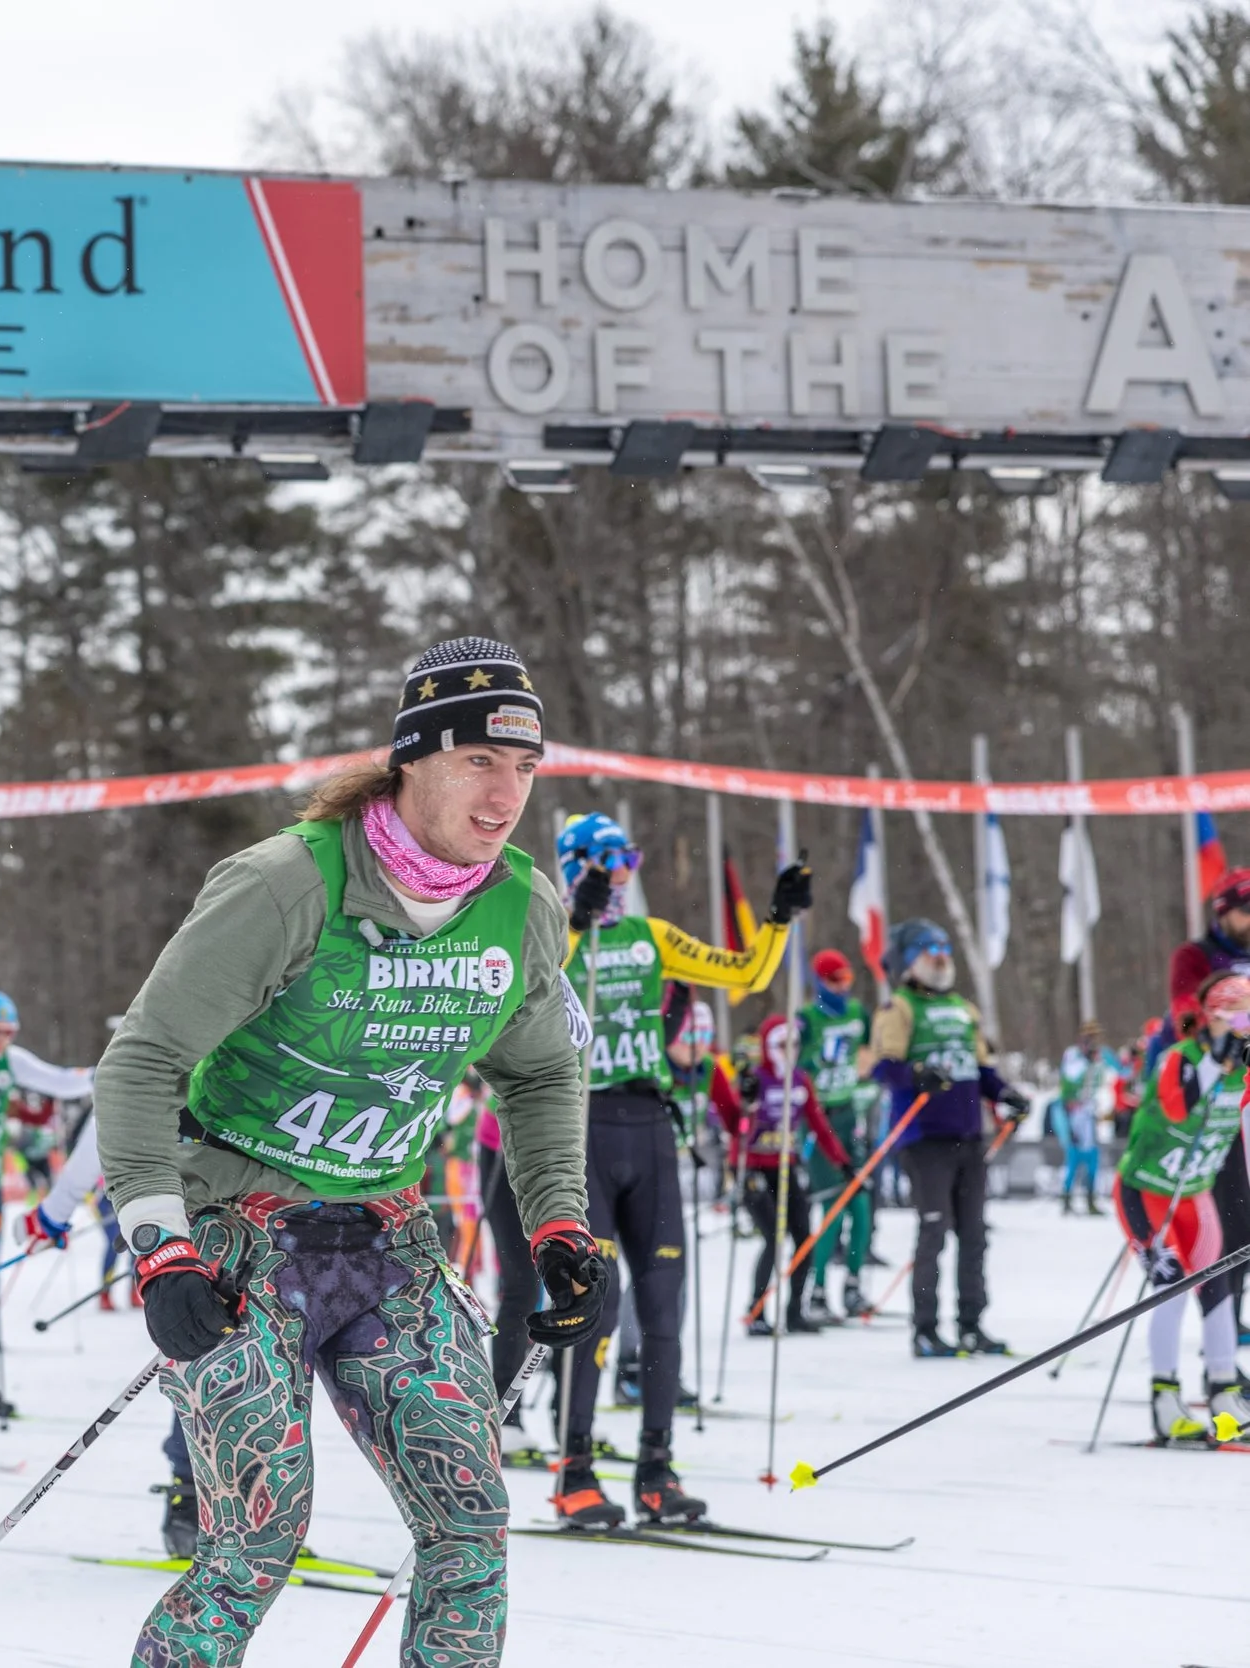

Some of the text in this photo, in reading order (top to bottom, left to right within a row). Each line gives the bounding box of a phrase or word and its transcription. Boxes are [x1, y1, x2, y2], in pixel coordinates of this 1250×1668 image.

[483, 216, 858, 312] HOME
[1084, 250, 1222, 418] A
[486, 322, 946, 417] OF THE
[367, 955, 480, 991] BIRKIE
[485, 959, 507, 968] BIRKIE
[491, 969, 501, 989] 5
[327, 990, 505, 1015] Ski. Run. Bike. Live!
[364, 1023, 471, 1043] PIONEER
[381, 1041, 450, 1052] MIDWEST
[218, 1127, 383, 1179] 2026 American Birkebeiner
[556, 1316, 585, 1327] TOKO
